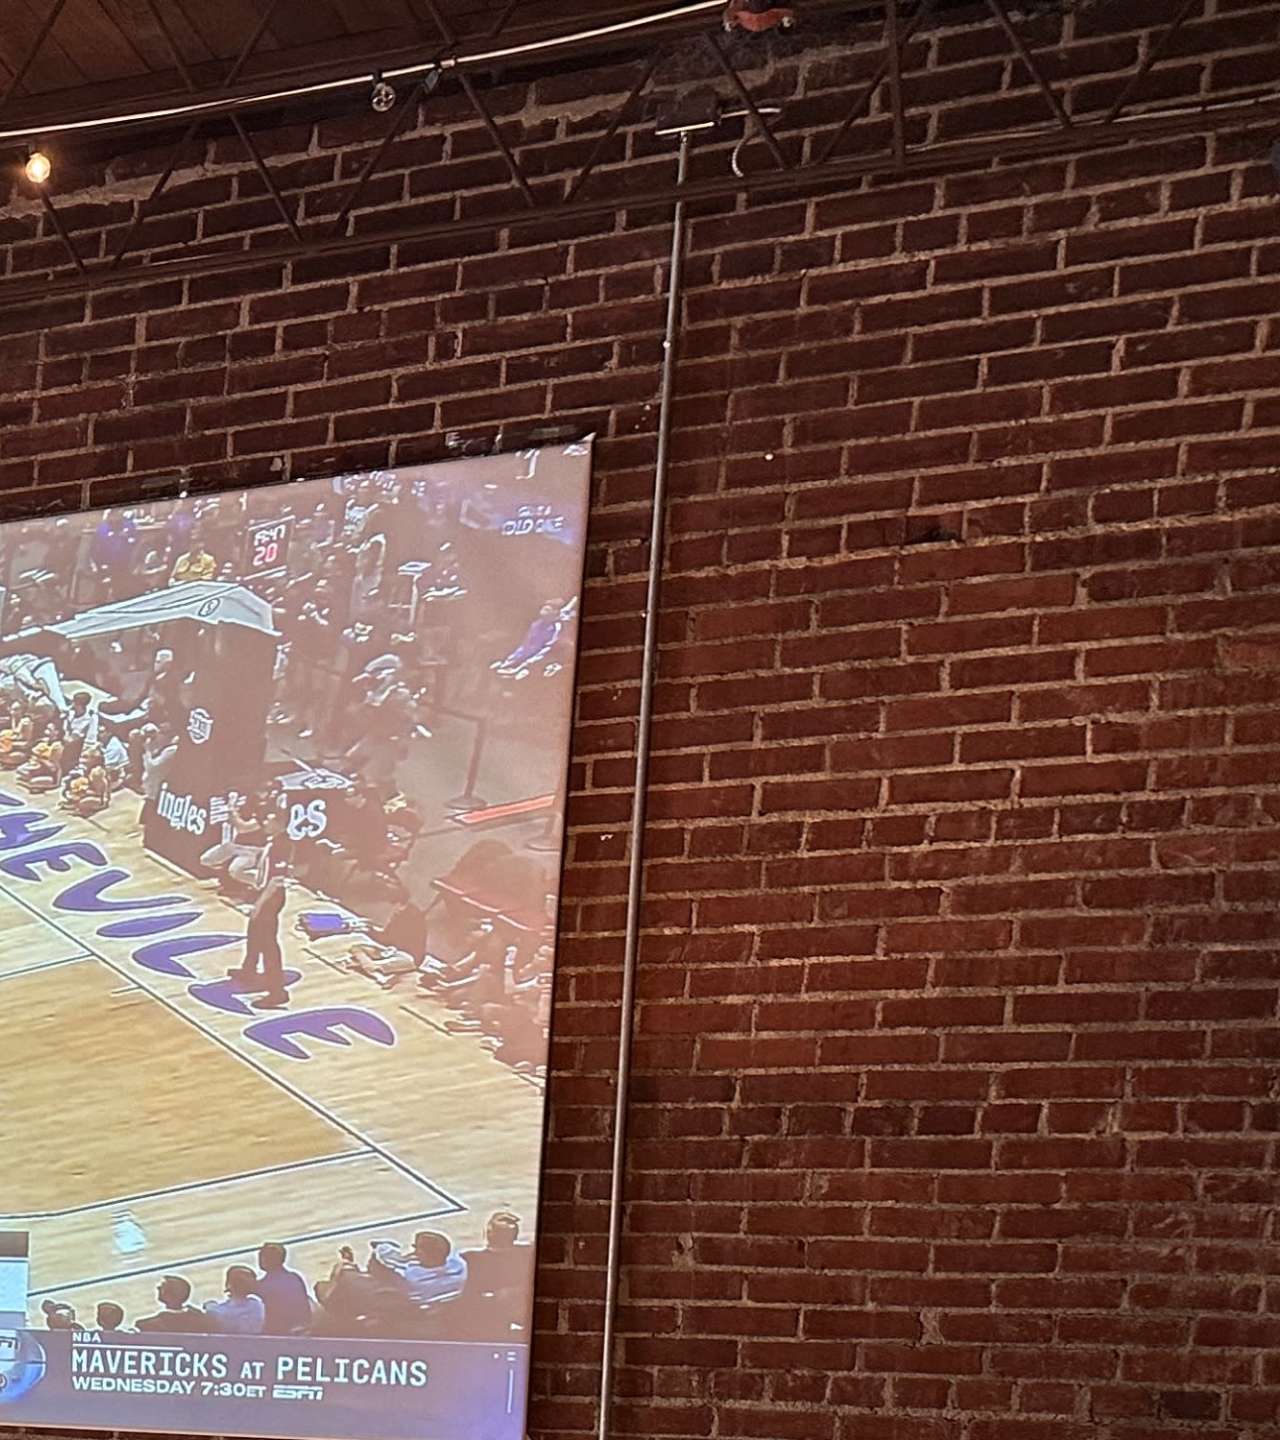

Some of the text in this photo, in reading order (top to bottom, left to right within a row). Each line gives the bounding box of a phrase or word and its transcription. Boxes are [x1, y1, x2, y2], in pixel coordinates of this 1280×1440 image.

[156, 782, 207, 836] ingles
[72, 1332, 102, 1343] NBA
[71, 1348, 428, 1387] MAVERICKS AT PELICANS
[72, 1375, 324, 1401] WEDNESDAY 7:30ET ESPN
